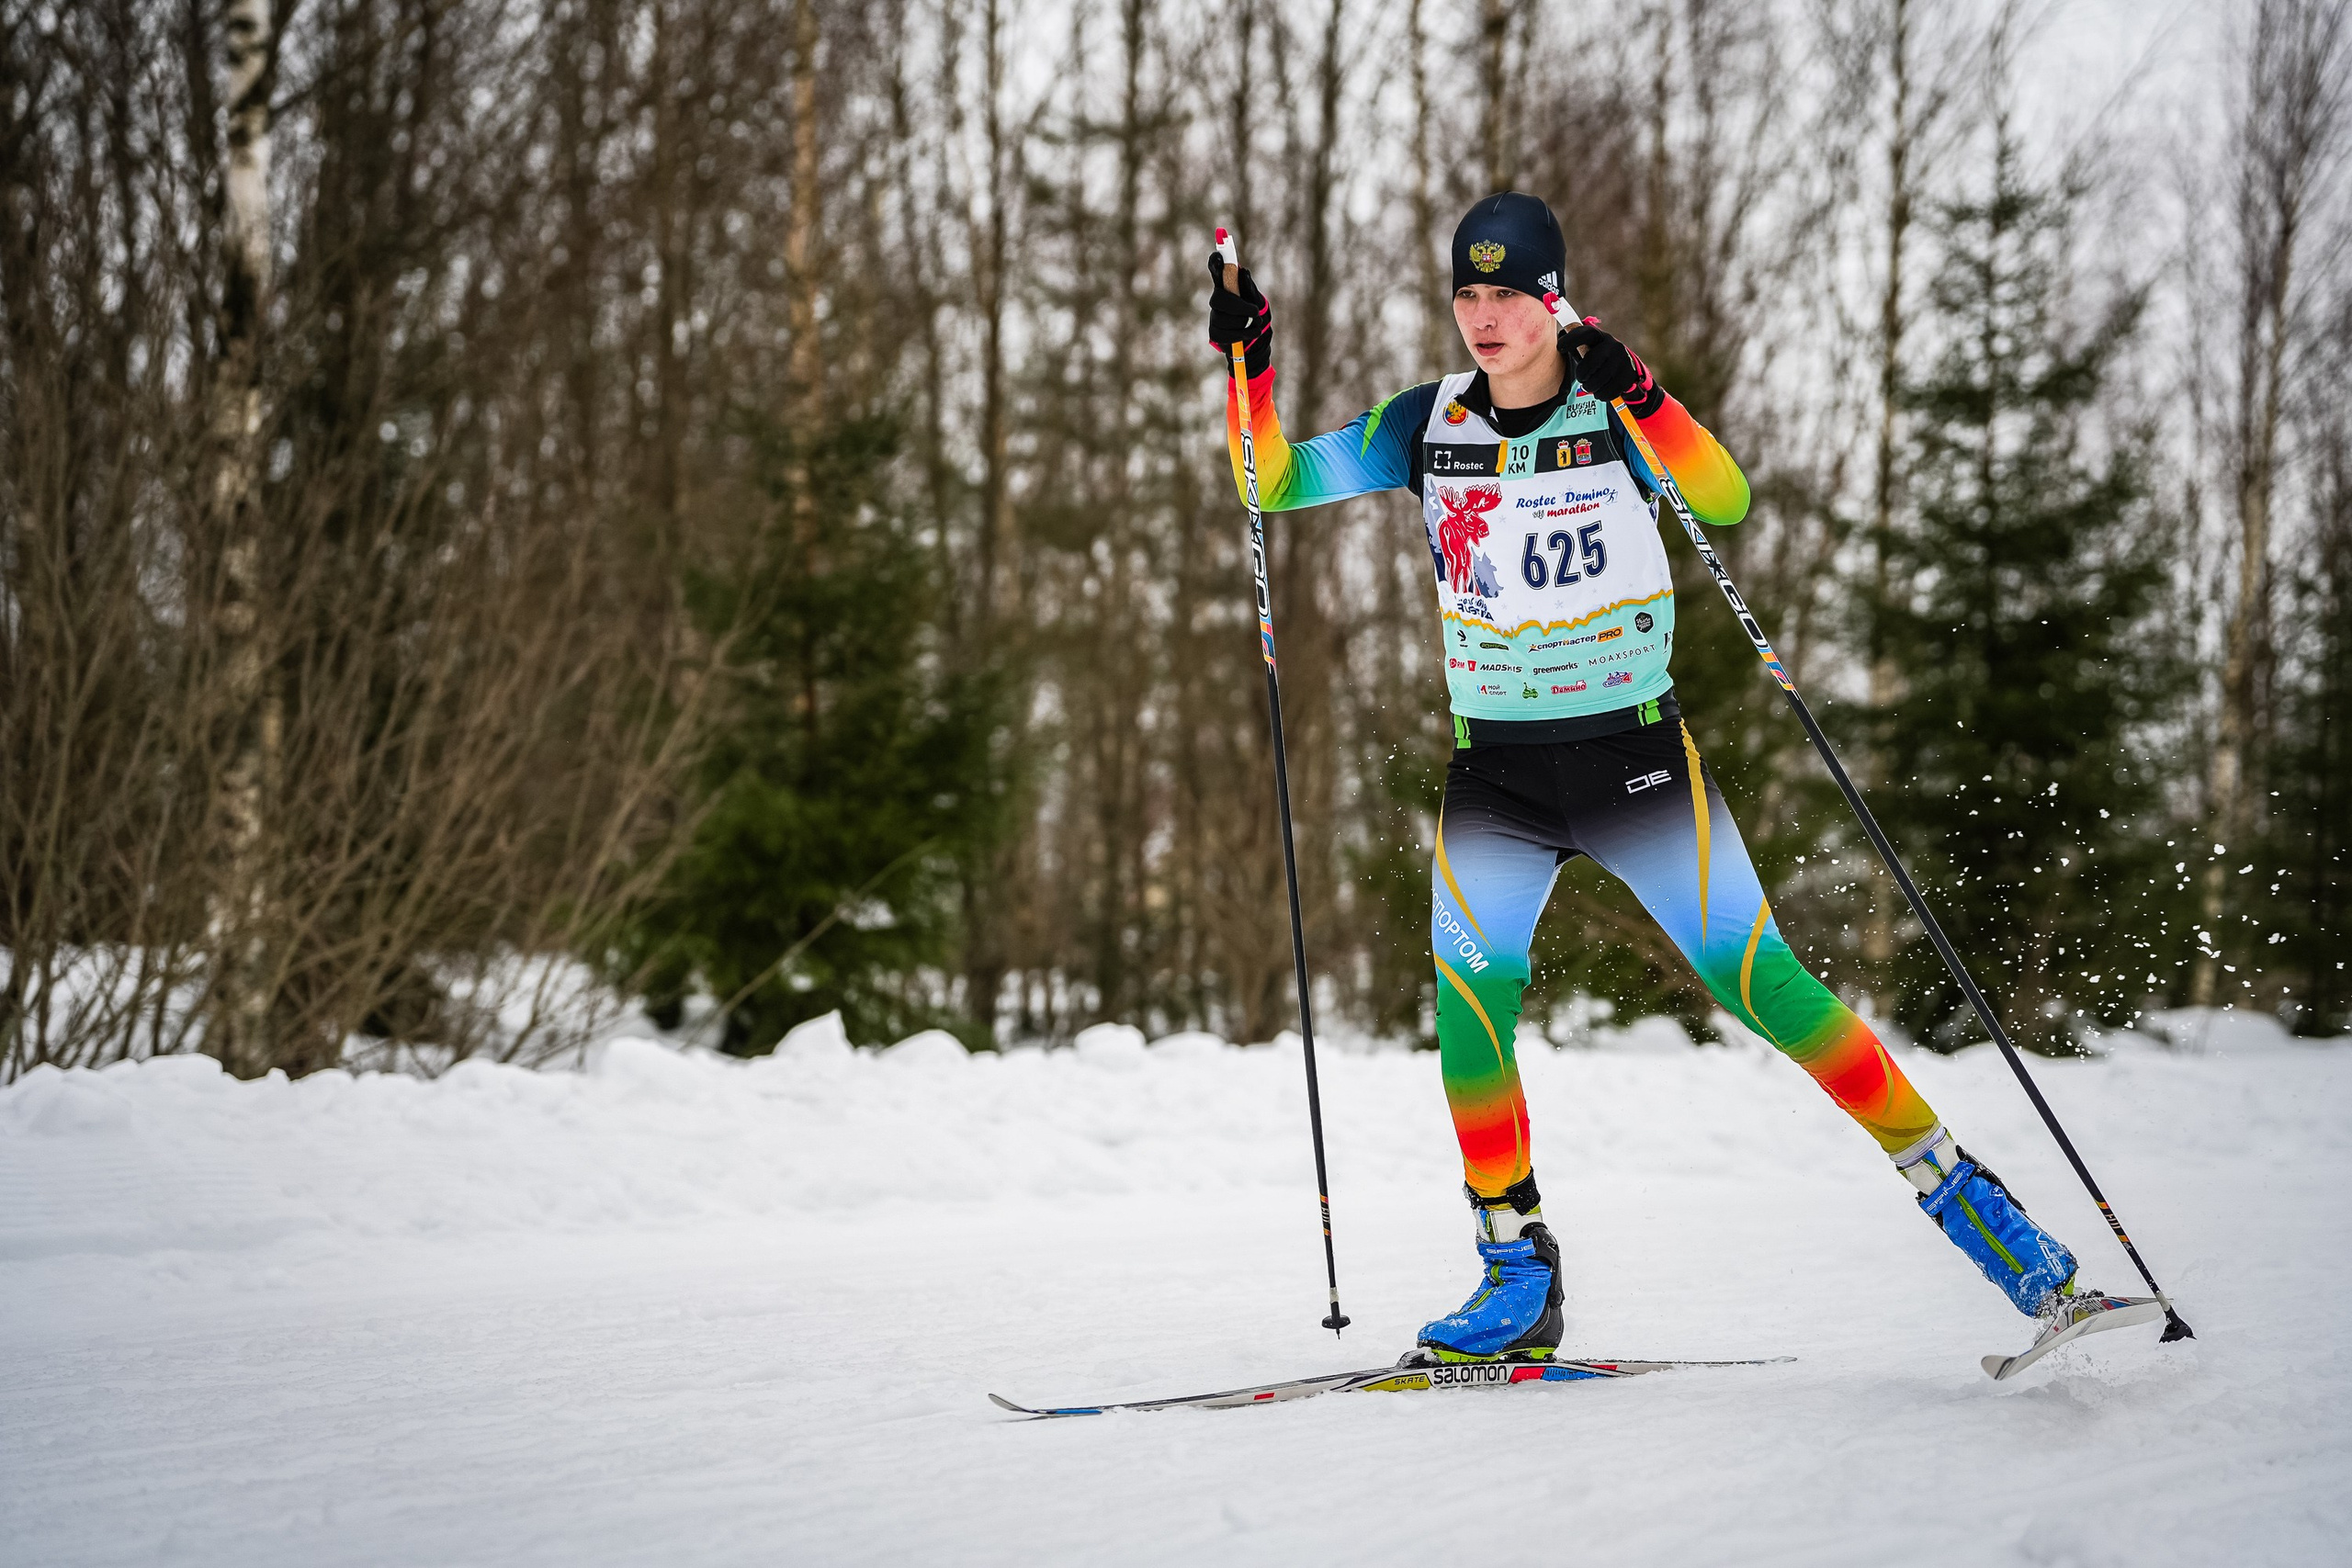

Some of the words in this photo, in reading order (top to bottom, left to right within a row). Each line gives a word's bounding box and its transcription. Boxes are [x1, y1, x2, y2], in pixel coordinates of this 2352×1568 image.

[1537, 278, 1560, 296] adidas
[1566, 400, 1597, 412] RUSSIA
[1511, 446, 1529, 460] 10
[1453, 461, 1485, 470] Rostec
[1508, 462, 1526, 475] KM
[1515, 494, 1556, 509] Rostec
[1565, 487, 1610, 502] Demino
[1546, 502, 1600, 517] marathon
[1521, 520, 1608, 590] 625
[1537, 634, 1597, 650] спортмастер
[1599, 628, 1622, 641] PRO
[1589, 644, 1656, 667] MOAXSPORT
[1532, 661, 1578, 675] greenworks
[1926, 1171, 1963, 1213] SPINE
[1486, 1244, 1533, 1255] SPINE
[1395, 1377, 1424, 1385] SKATE
